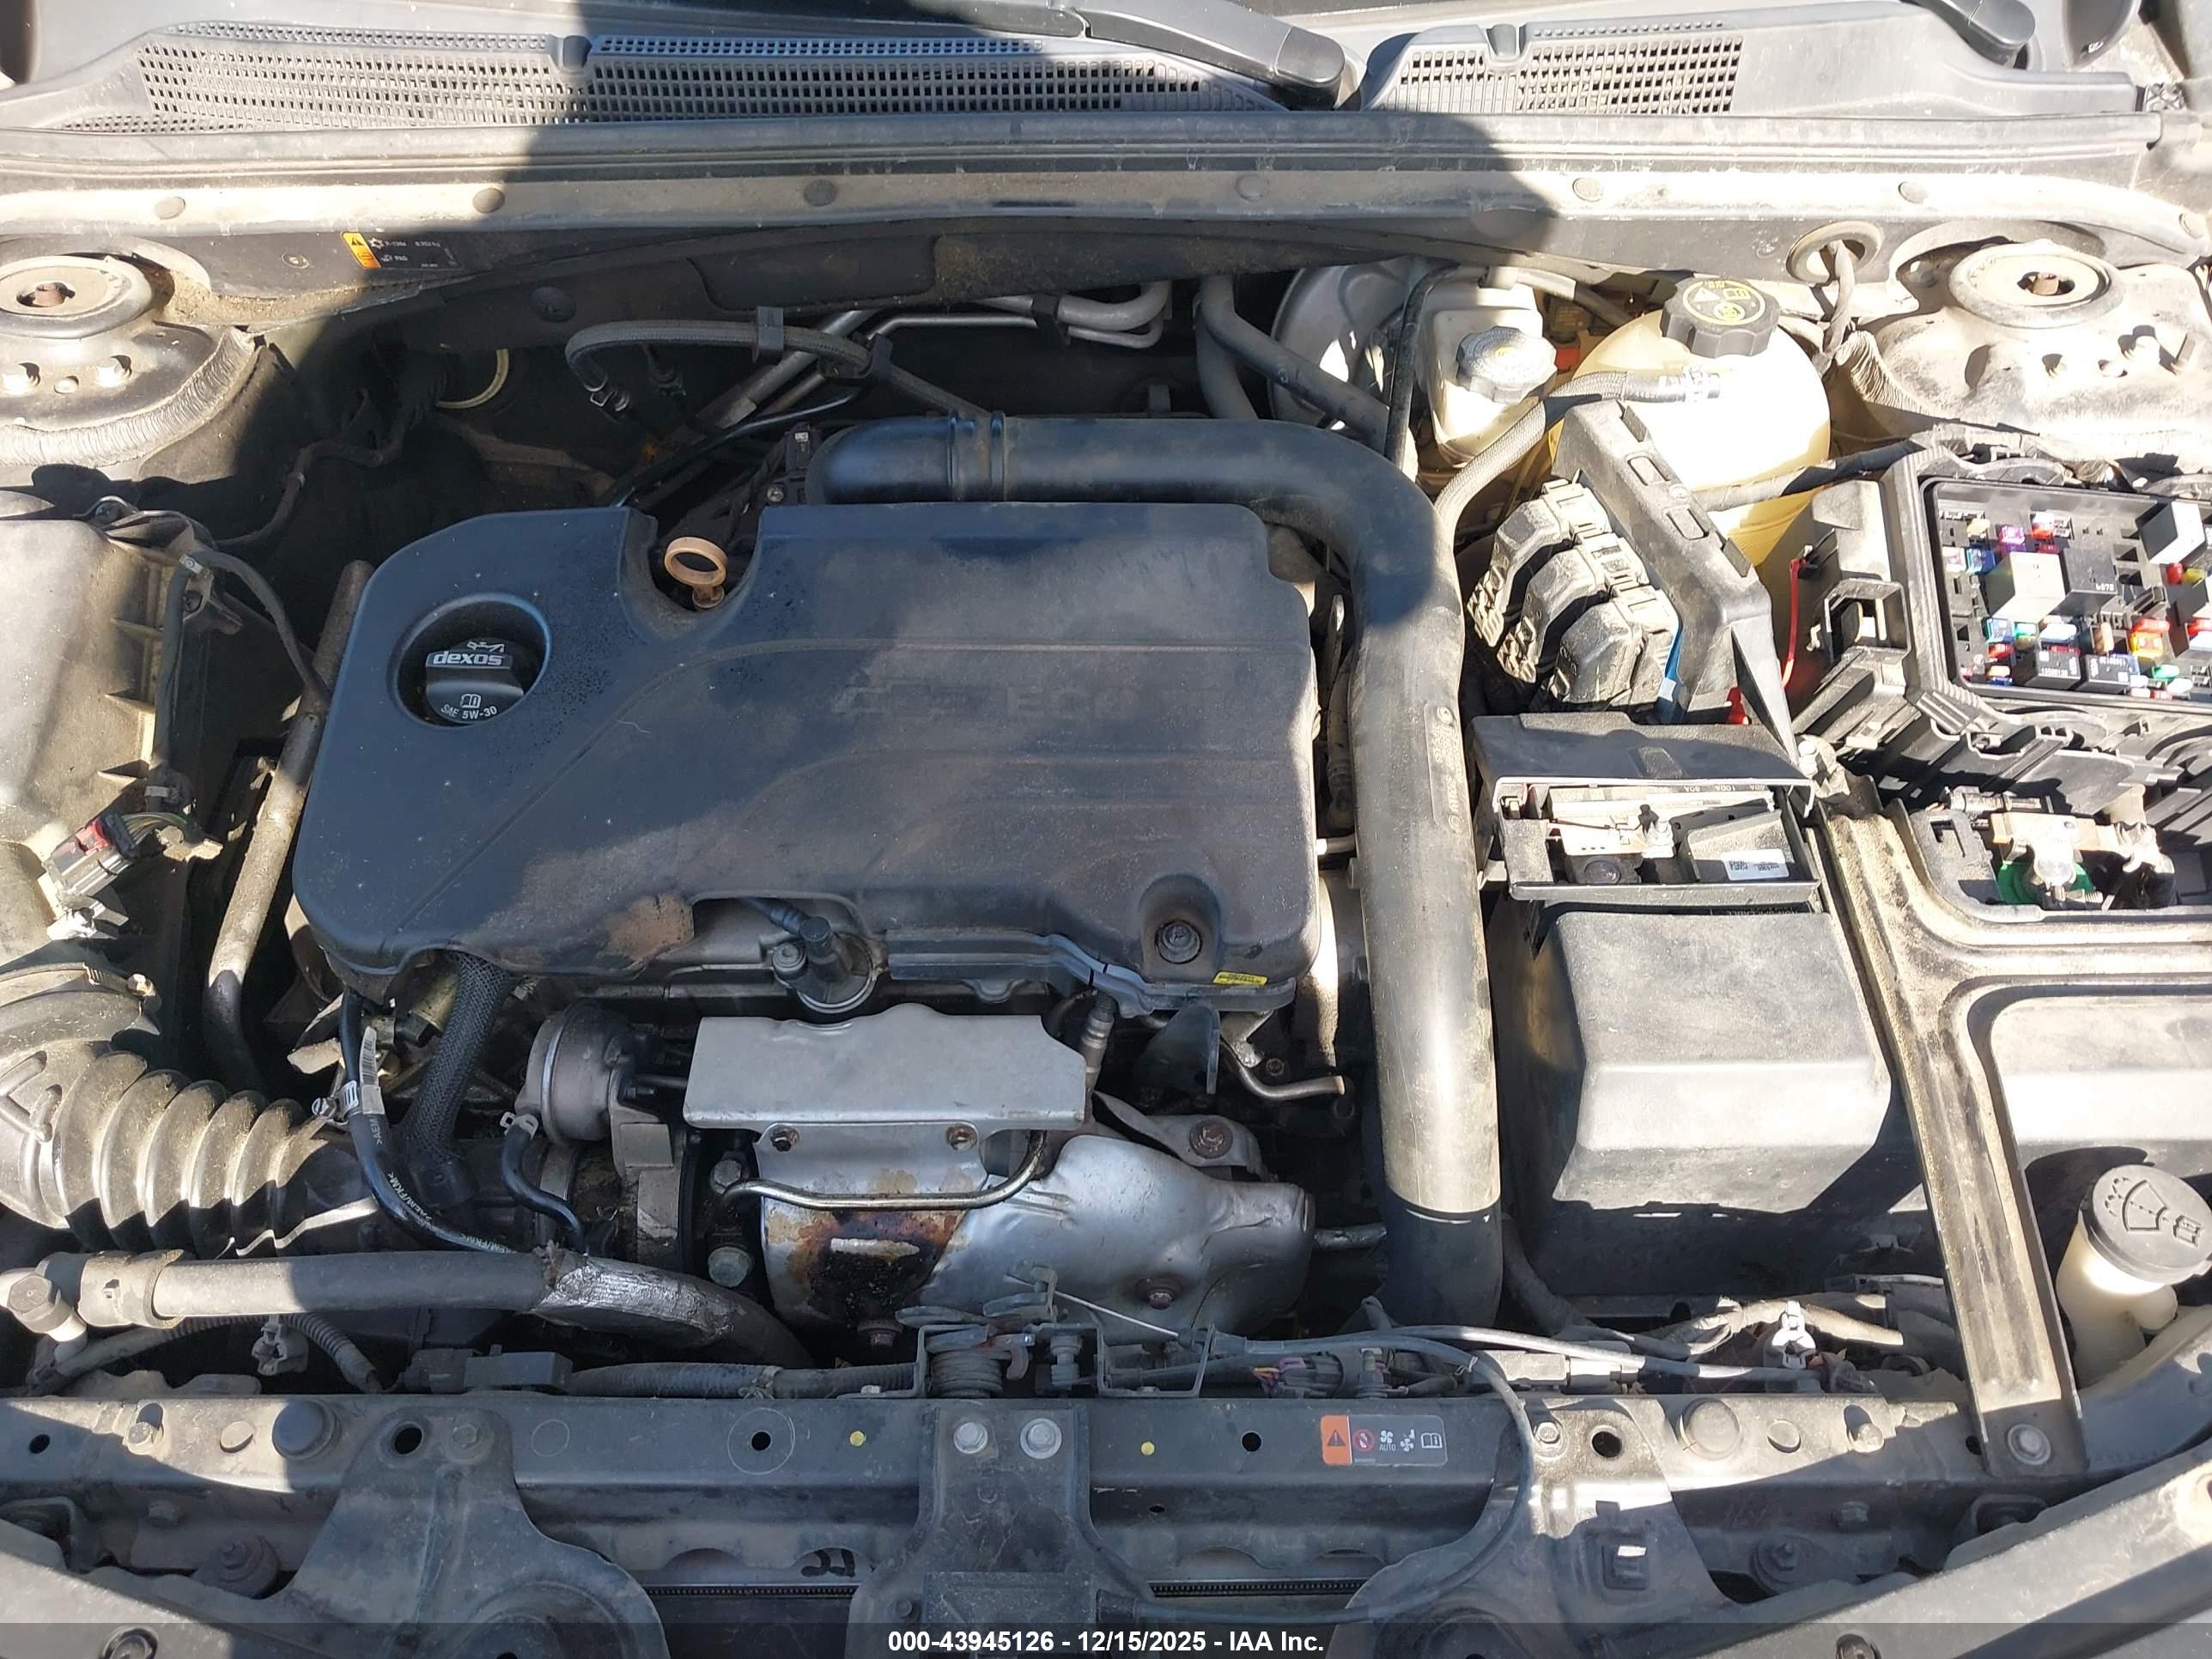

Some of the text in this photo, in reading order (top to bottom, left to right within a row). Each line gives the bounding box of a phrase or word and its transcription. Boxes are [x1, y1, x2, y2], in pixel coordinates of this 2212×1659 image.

[433, 650, 502, 666] dexos
[441, 703, 498, 720] SAE 5W-30
[1379, 1443, 1396, 1452] AUTO
